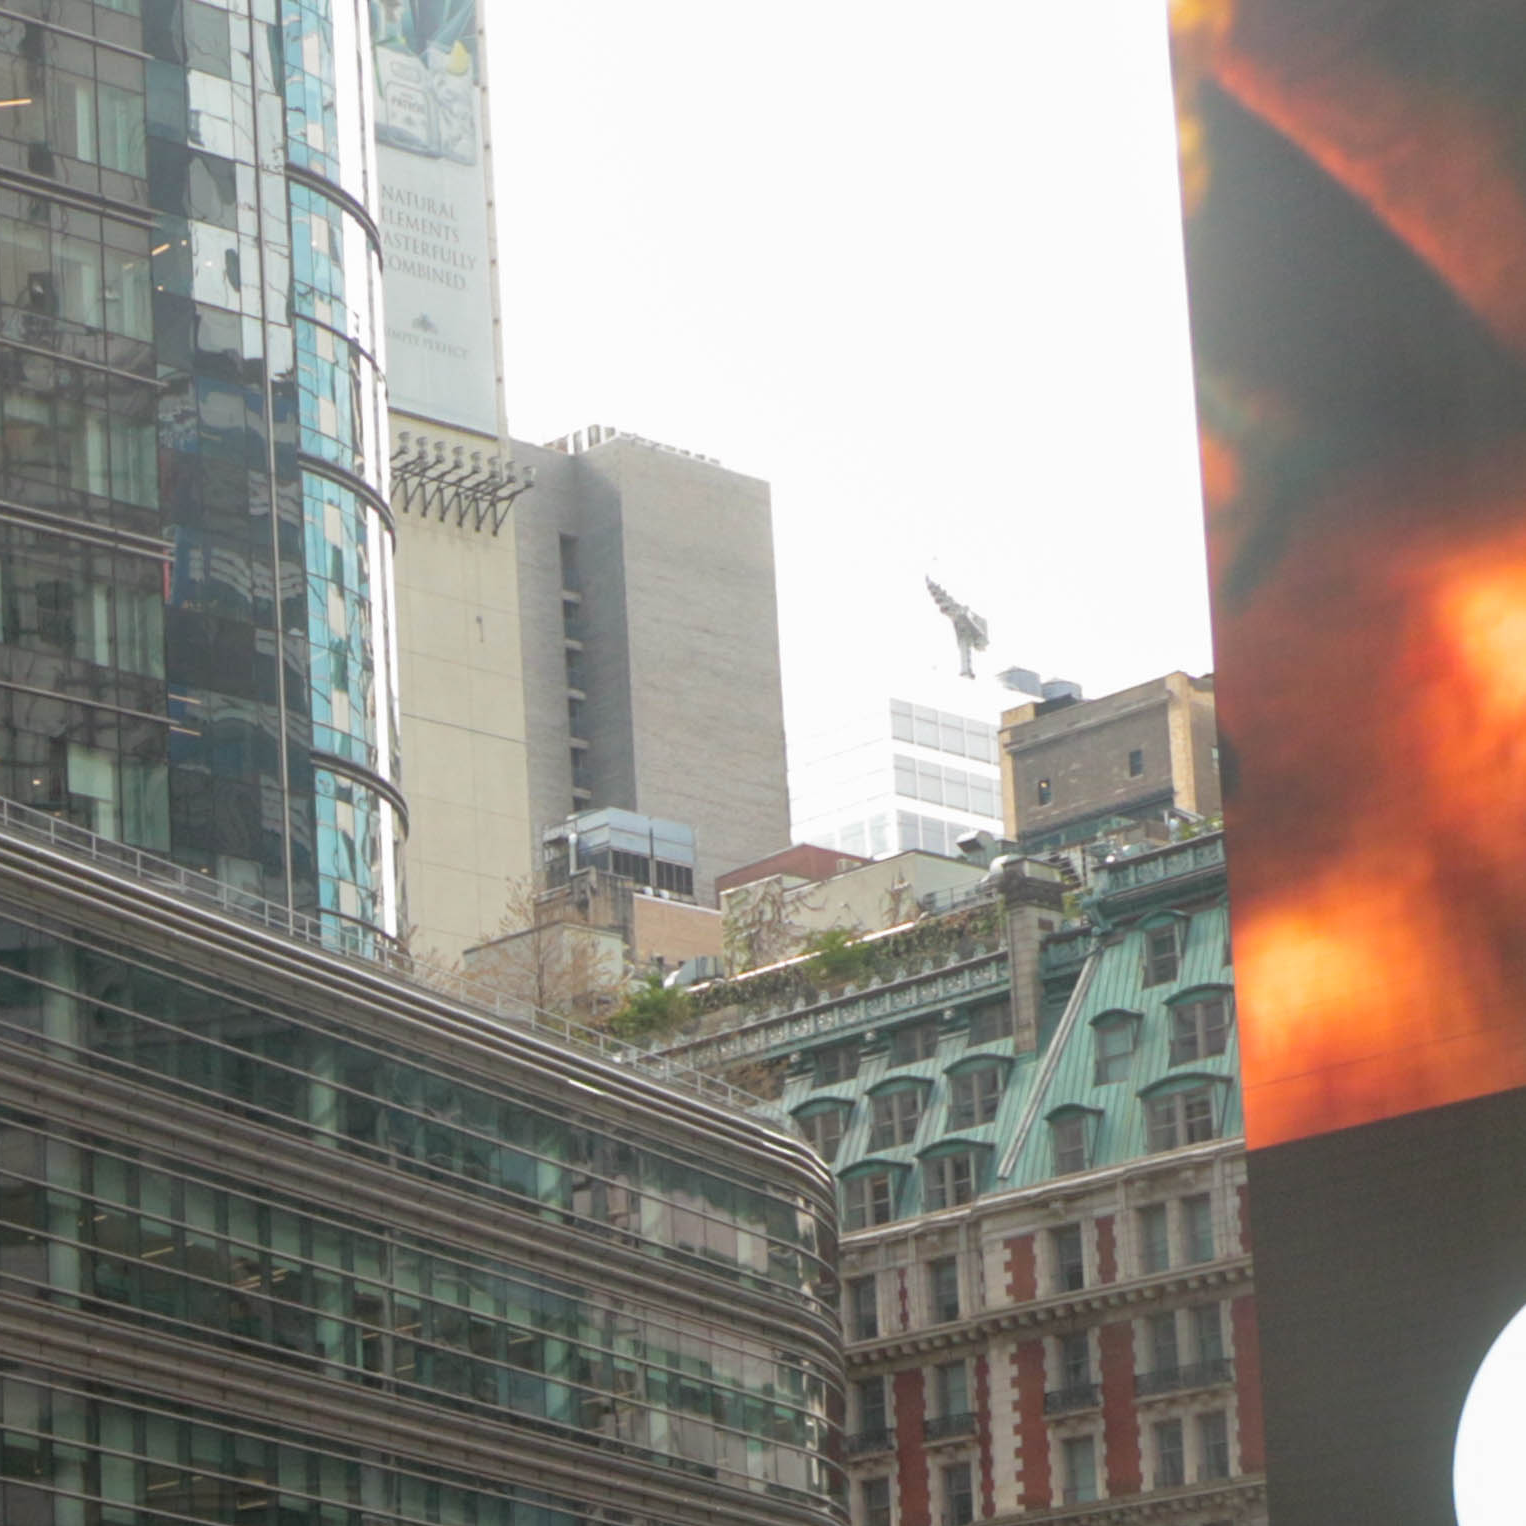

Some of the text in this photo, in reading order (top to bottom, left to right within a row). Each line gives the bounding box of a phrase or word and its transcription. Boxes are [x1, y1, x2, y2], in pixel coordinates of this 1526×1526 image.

[381, 185, 459, 222] NATURAL
[380, 206, 460, 243] ELEMENTS
[382, 231, 477, 271] ASTERFULLY
